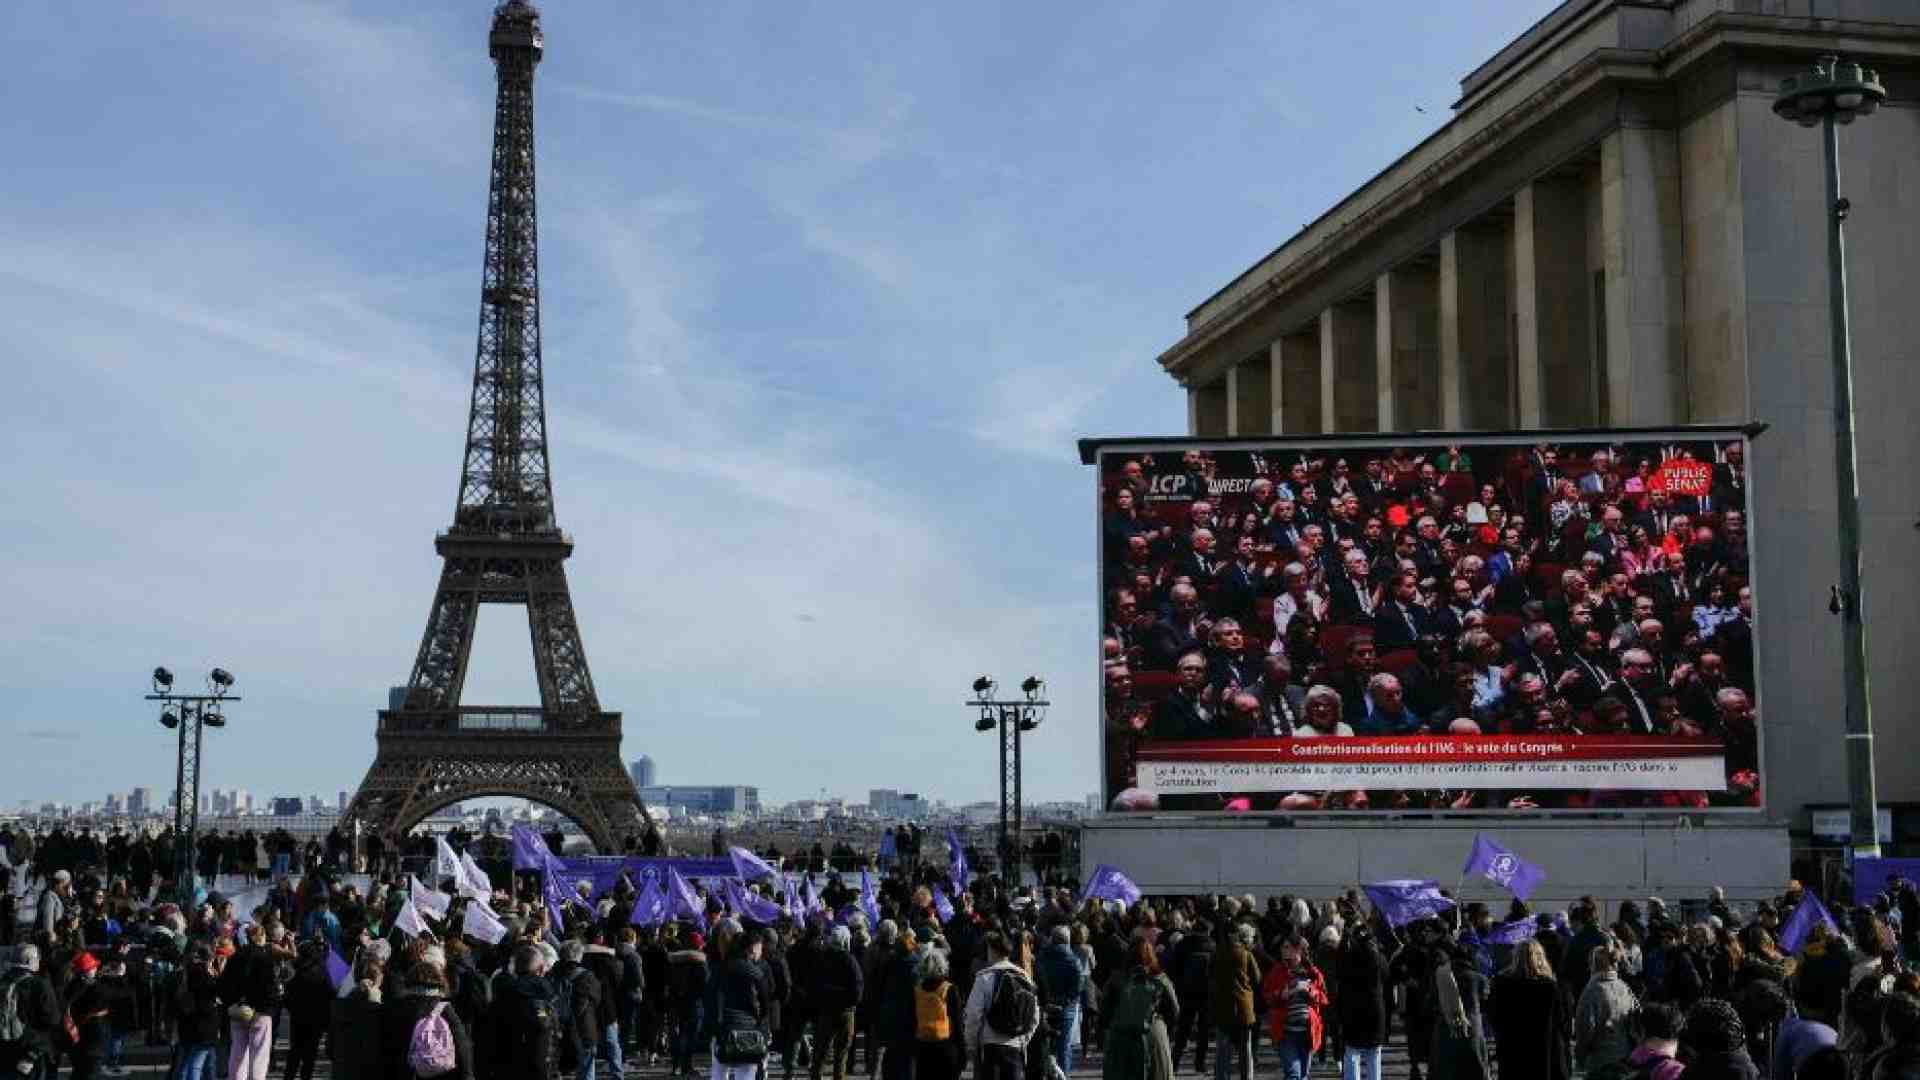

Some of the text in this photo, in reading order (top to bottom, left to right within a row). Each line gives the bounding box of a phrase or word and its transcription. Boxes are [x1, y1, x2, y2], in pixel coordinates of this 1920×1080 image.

[1664, 467, 1706, 478] PUBLIC
[1149, 474, 1187, 493] LCP
[1207, 478, 1251, 493] DIRECT
[1414, 742, 1427, 753] de
[1463, 742, 1474, 752] le
[1477, 742, 1499, 752] vote
[1502, 742, 1518, 752] du
